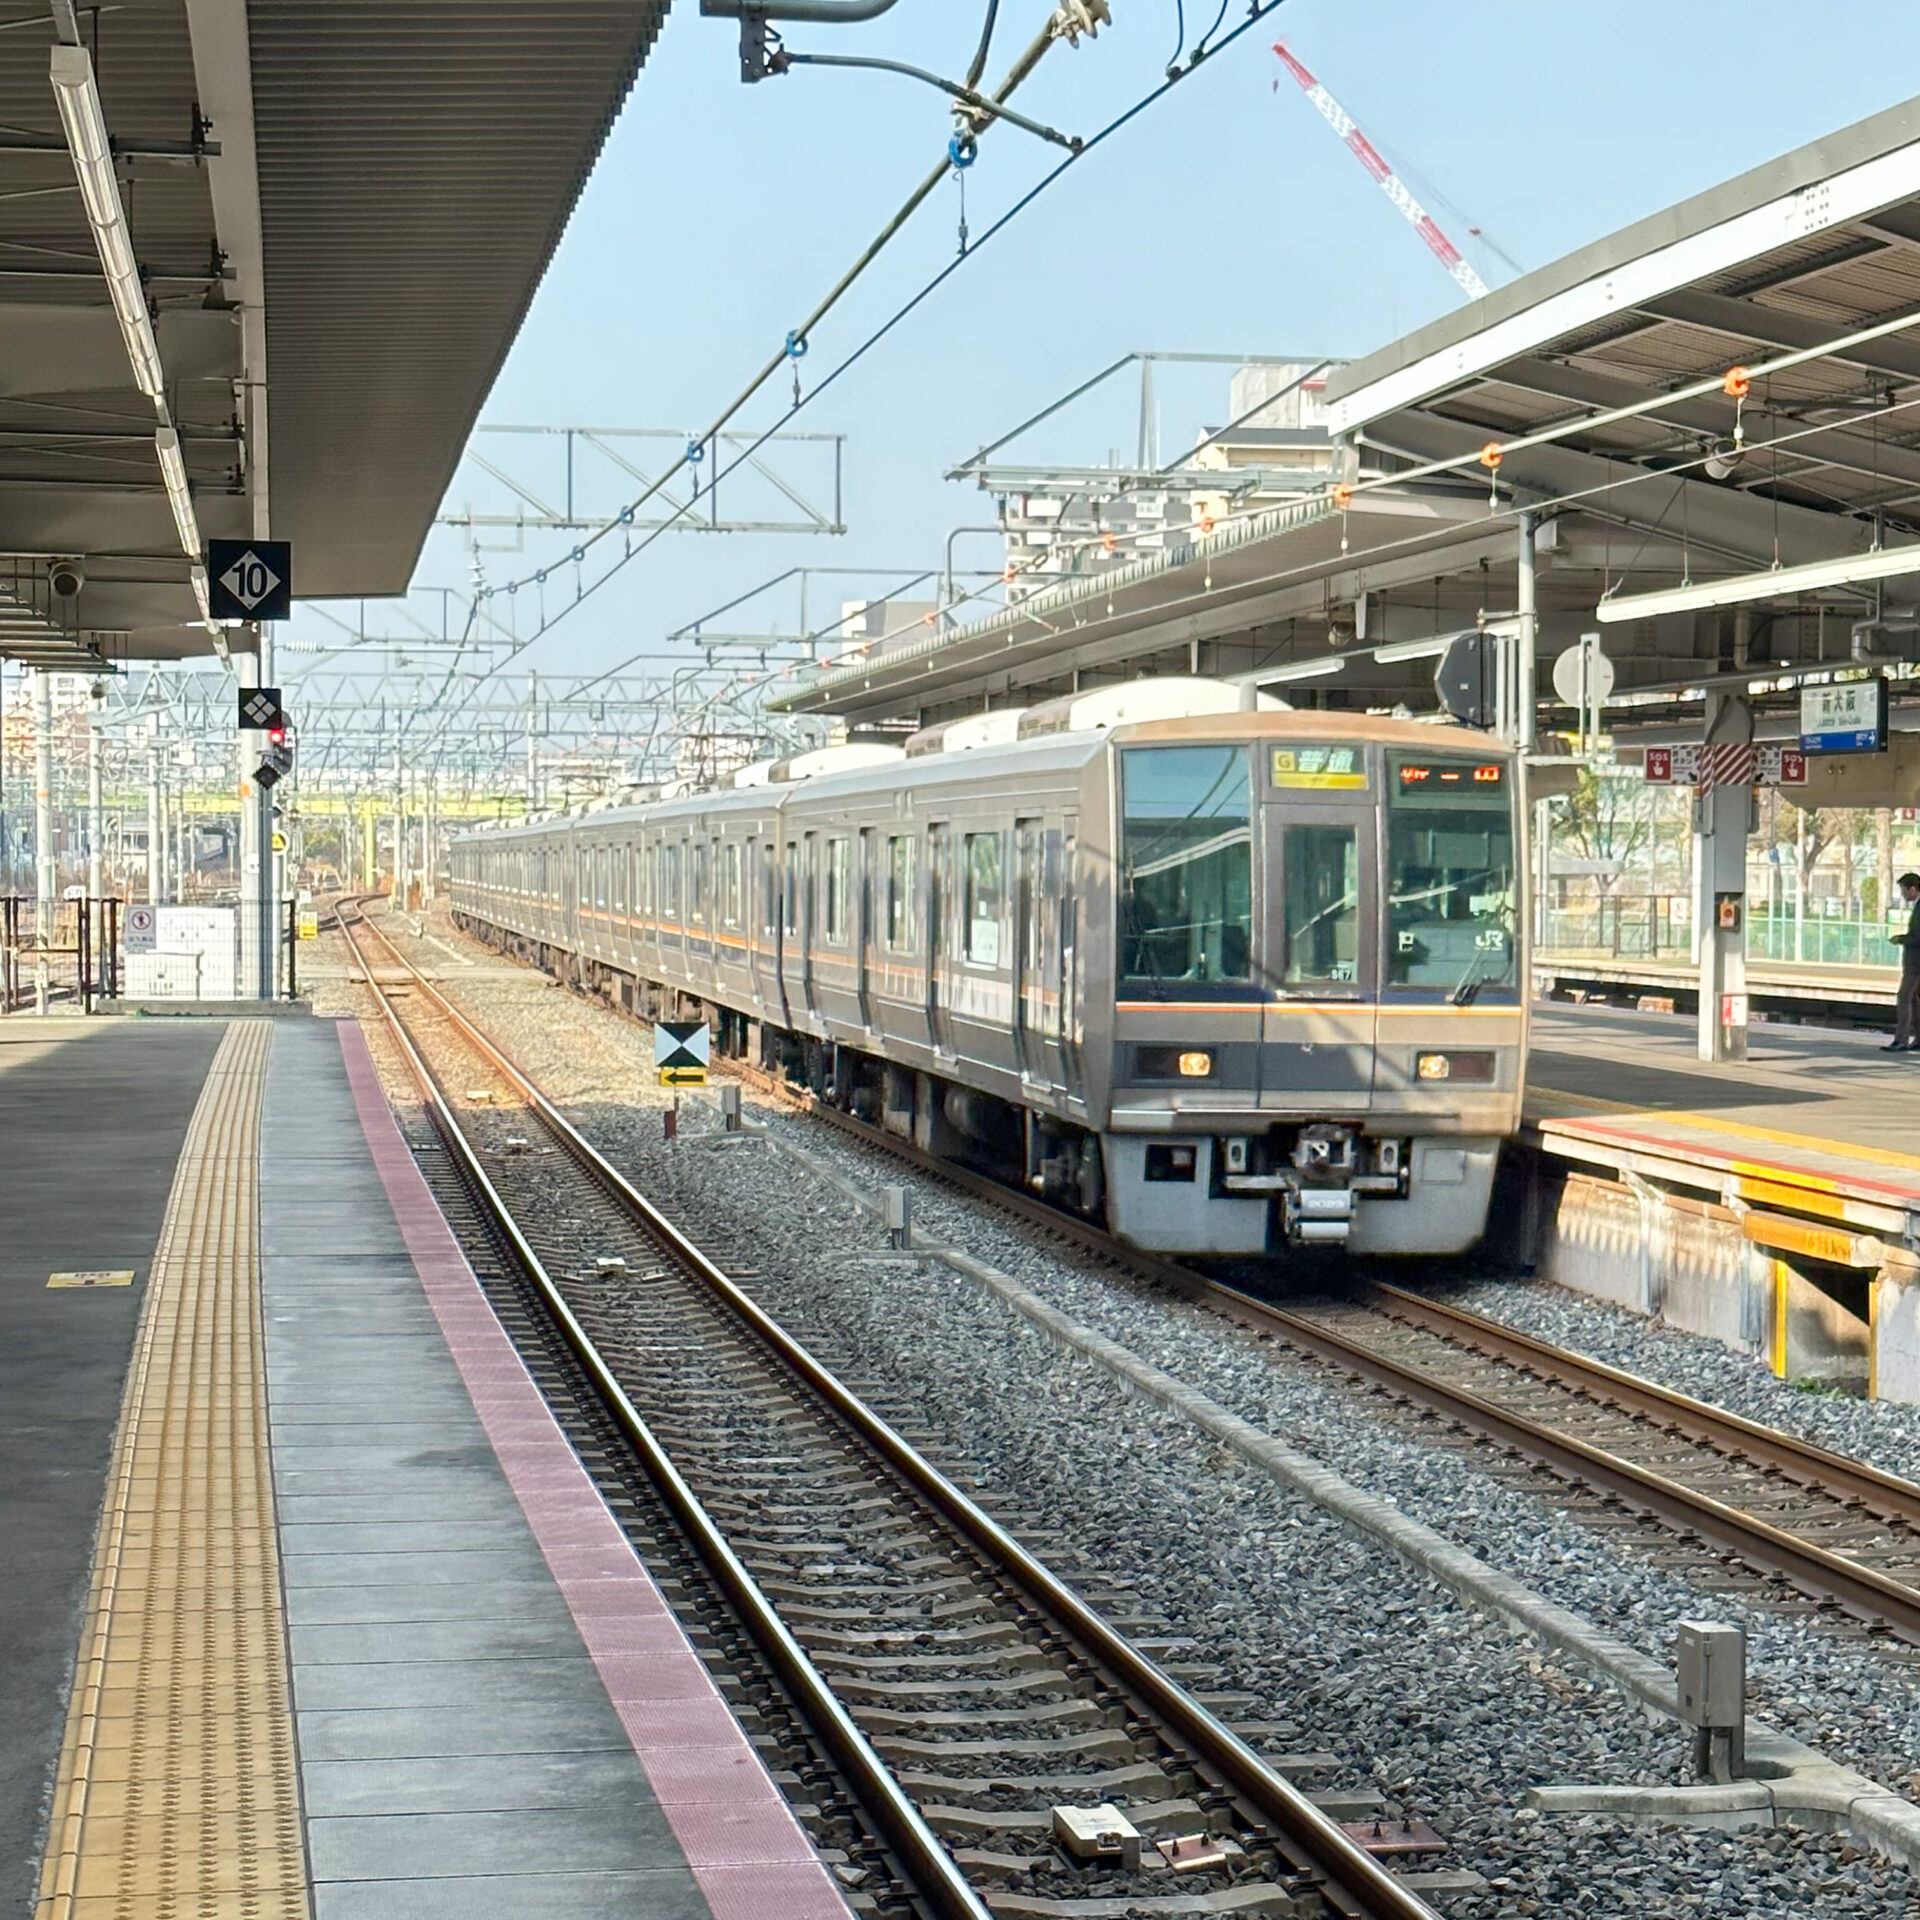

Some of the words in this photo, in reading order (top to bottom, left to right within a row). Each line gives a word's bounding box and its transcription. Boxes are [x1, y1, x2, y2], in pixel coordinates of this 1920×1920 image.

[232, 562, 268, 598] 10
[1278, 754, 1292, 769] G
[1298, 750, 1354, 773] 普通
[1649, 751, 1669, 761] SOS
[1783, 754, 1803, 763] SOS
[1475, 930, 1503, 947] JR
